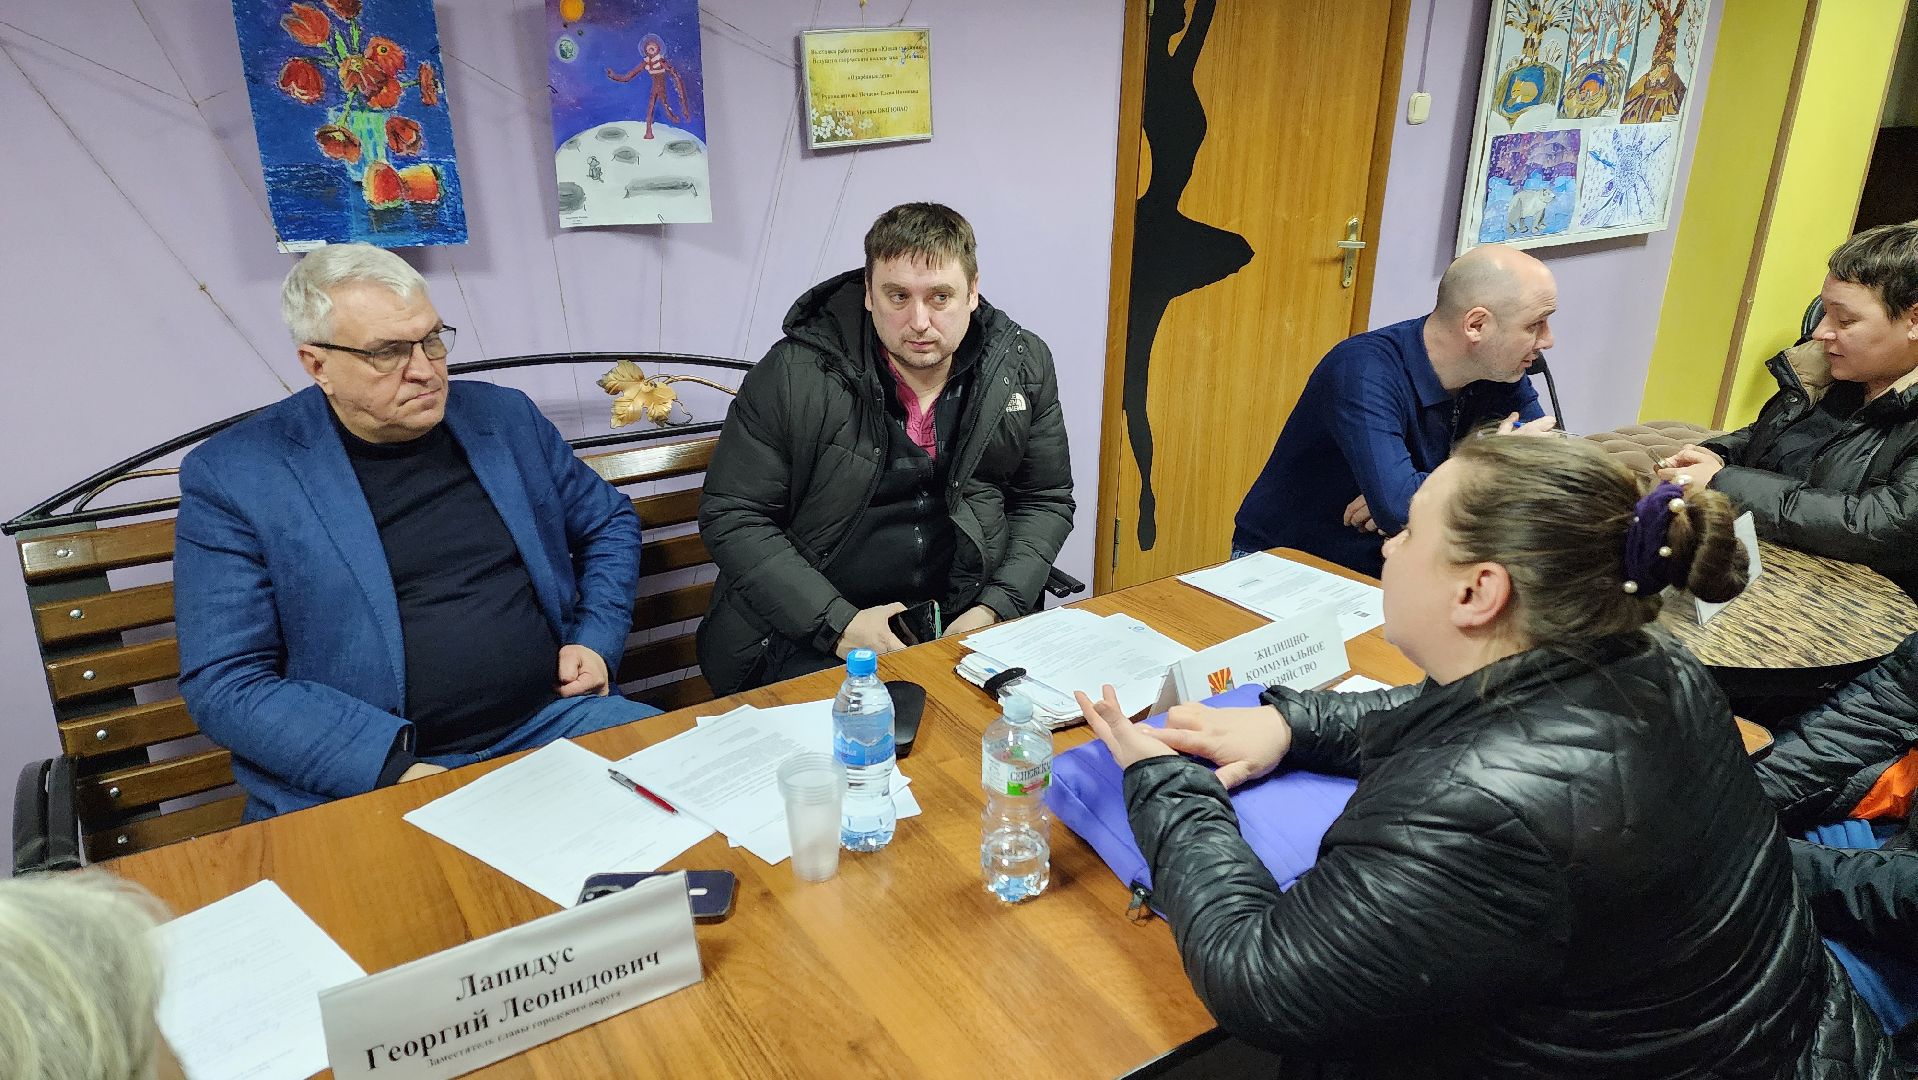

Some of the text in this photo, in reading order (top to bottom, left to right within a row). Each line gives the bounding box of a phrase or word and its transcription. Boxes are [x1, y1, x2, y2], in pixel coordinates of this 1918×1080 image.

[1245, 641, 1326, 682] КОММУНАЛЬНОЕ
[1254, 632, 1310, 661] ЖИЛИЩНО-
[456, 946, 576, 1001] Лапидус
[366, 951, 661, 1072] Георгий Леонидович
[428, 990, 622, 1068] Заместитель главы городского округа
